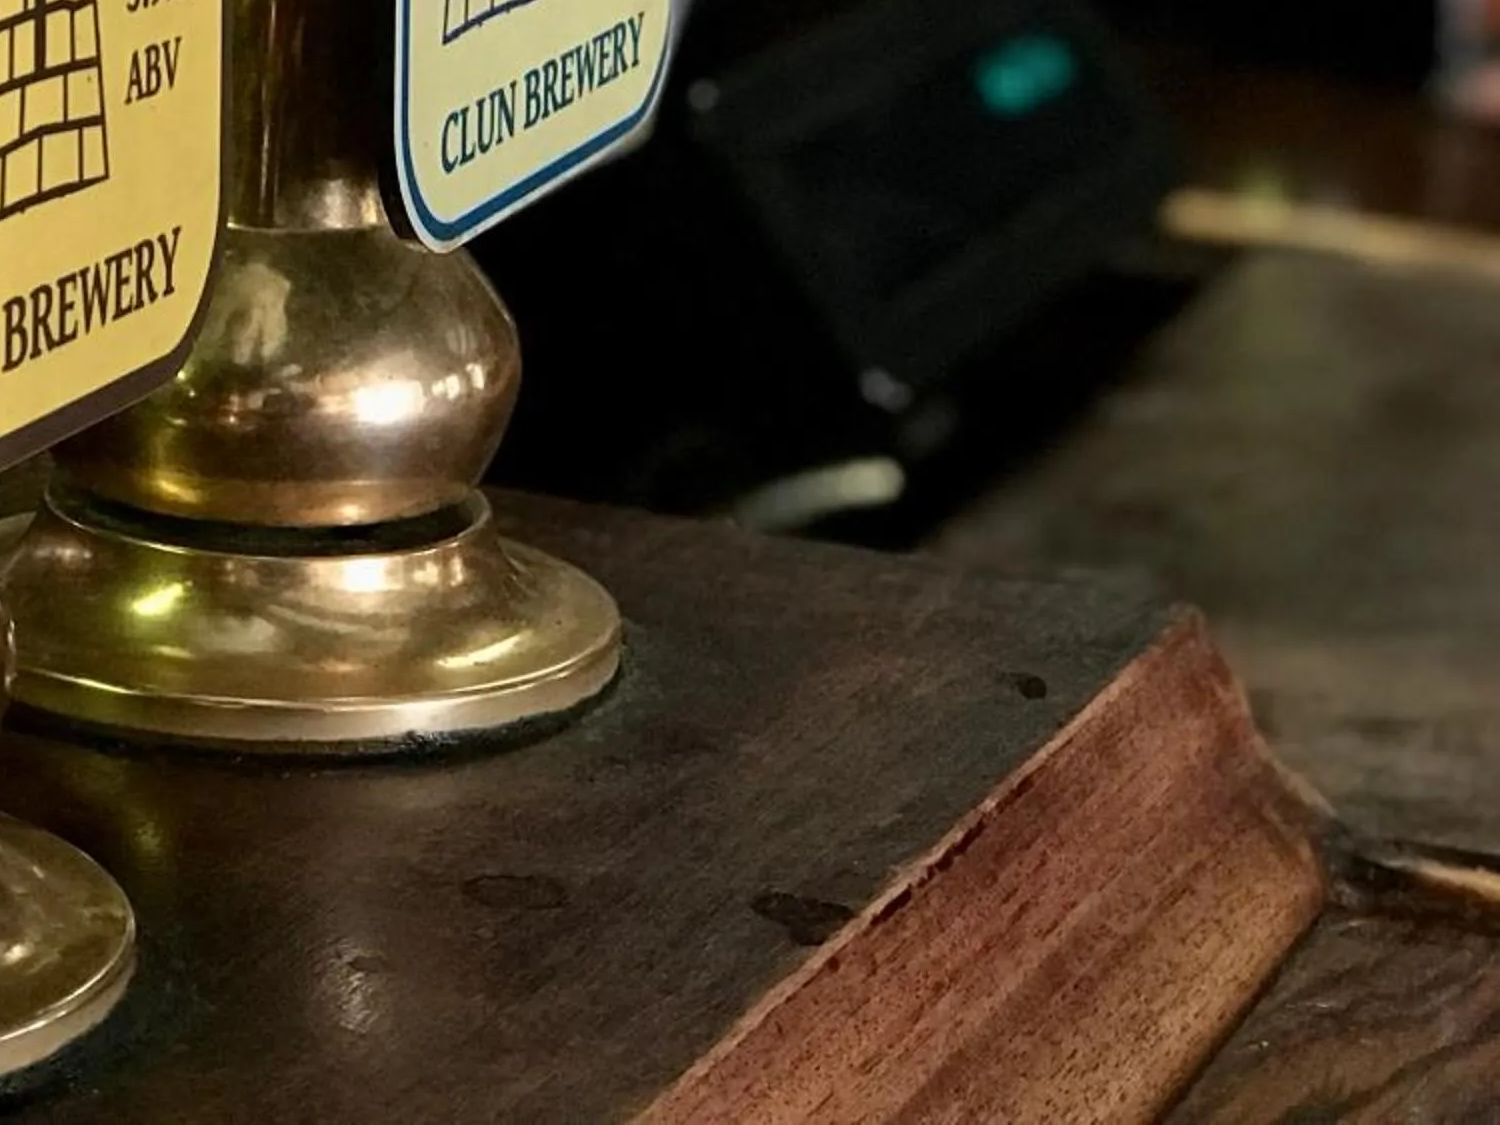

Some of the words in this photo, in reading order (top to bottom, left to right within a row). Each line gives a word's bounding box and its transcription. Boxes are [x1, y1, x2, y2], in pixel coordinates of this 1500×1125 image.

[125, 37, 182, 105] ABV
[441, 81, 517, 175] CLUN
[524, 12, 644, 130] BREWERY
[2, 226, 182, 373] BREWERY
